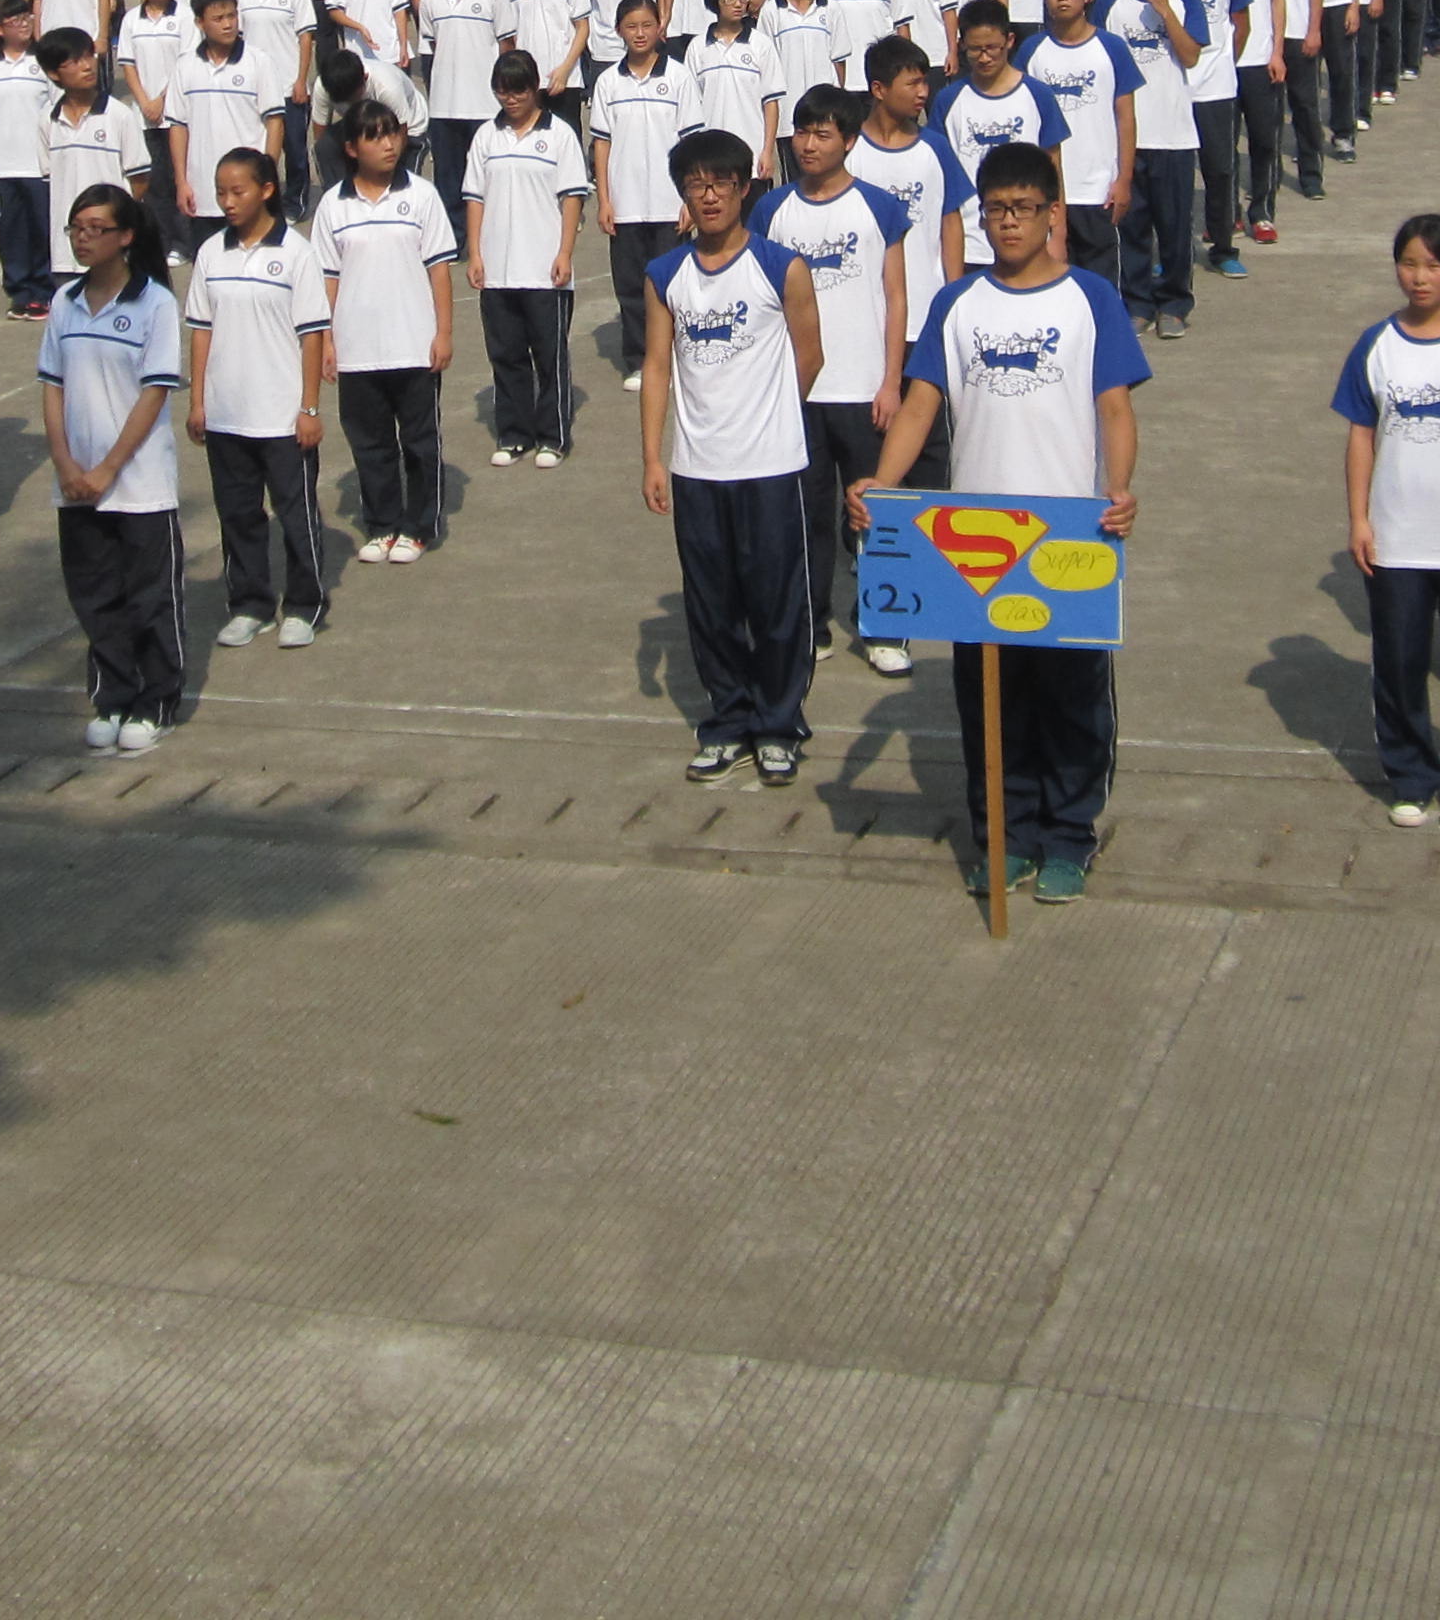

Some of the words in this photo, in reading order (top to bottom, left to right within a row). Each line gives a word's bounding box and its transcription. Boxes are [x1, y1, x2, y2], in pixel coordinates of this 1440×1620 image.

[1086, 70, 1096, 87] 2
[1014, 116, 1024, 134] 2
[913, 182, 924, 201] 2
[844, 231, 859, 255] 2
[734, 300, 749, 325] 2
[1043, 327, 1060, 355] 2
[866, 526, 911, 558] 三
[932, 507, 1030, 578] S
[1034, 546, 1109, 578] Super
[863, 584, 922, 614] (2)
[989, 596, 1048, 623] Class
